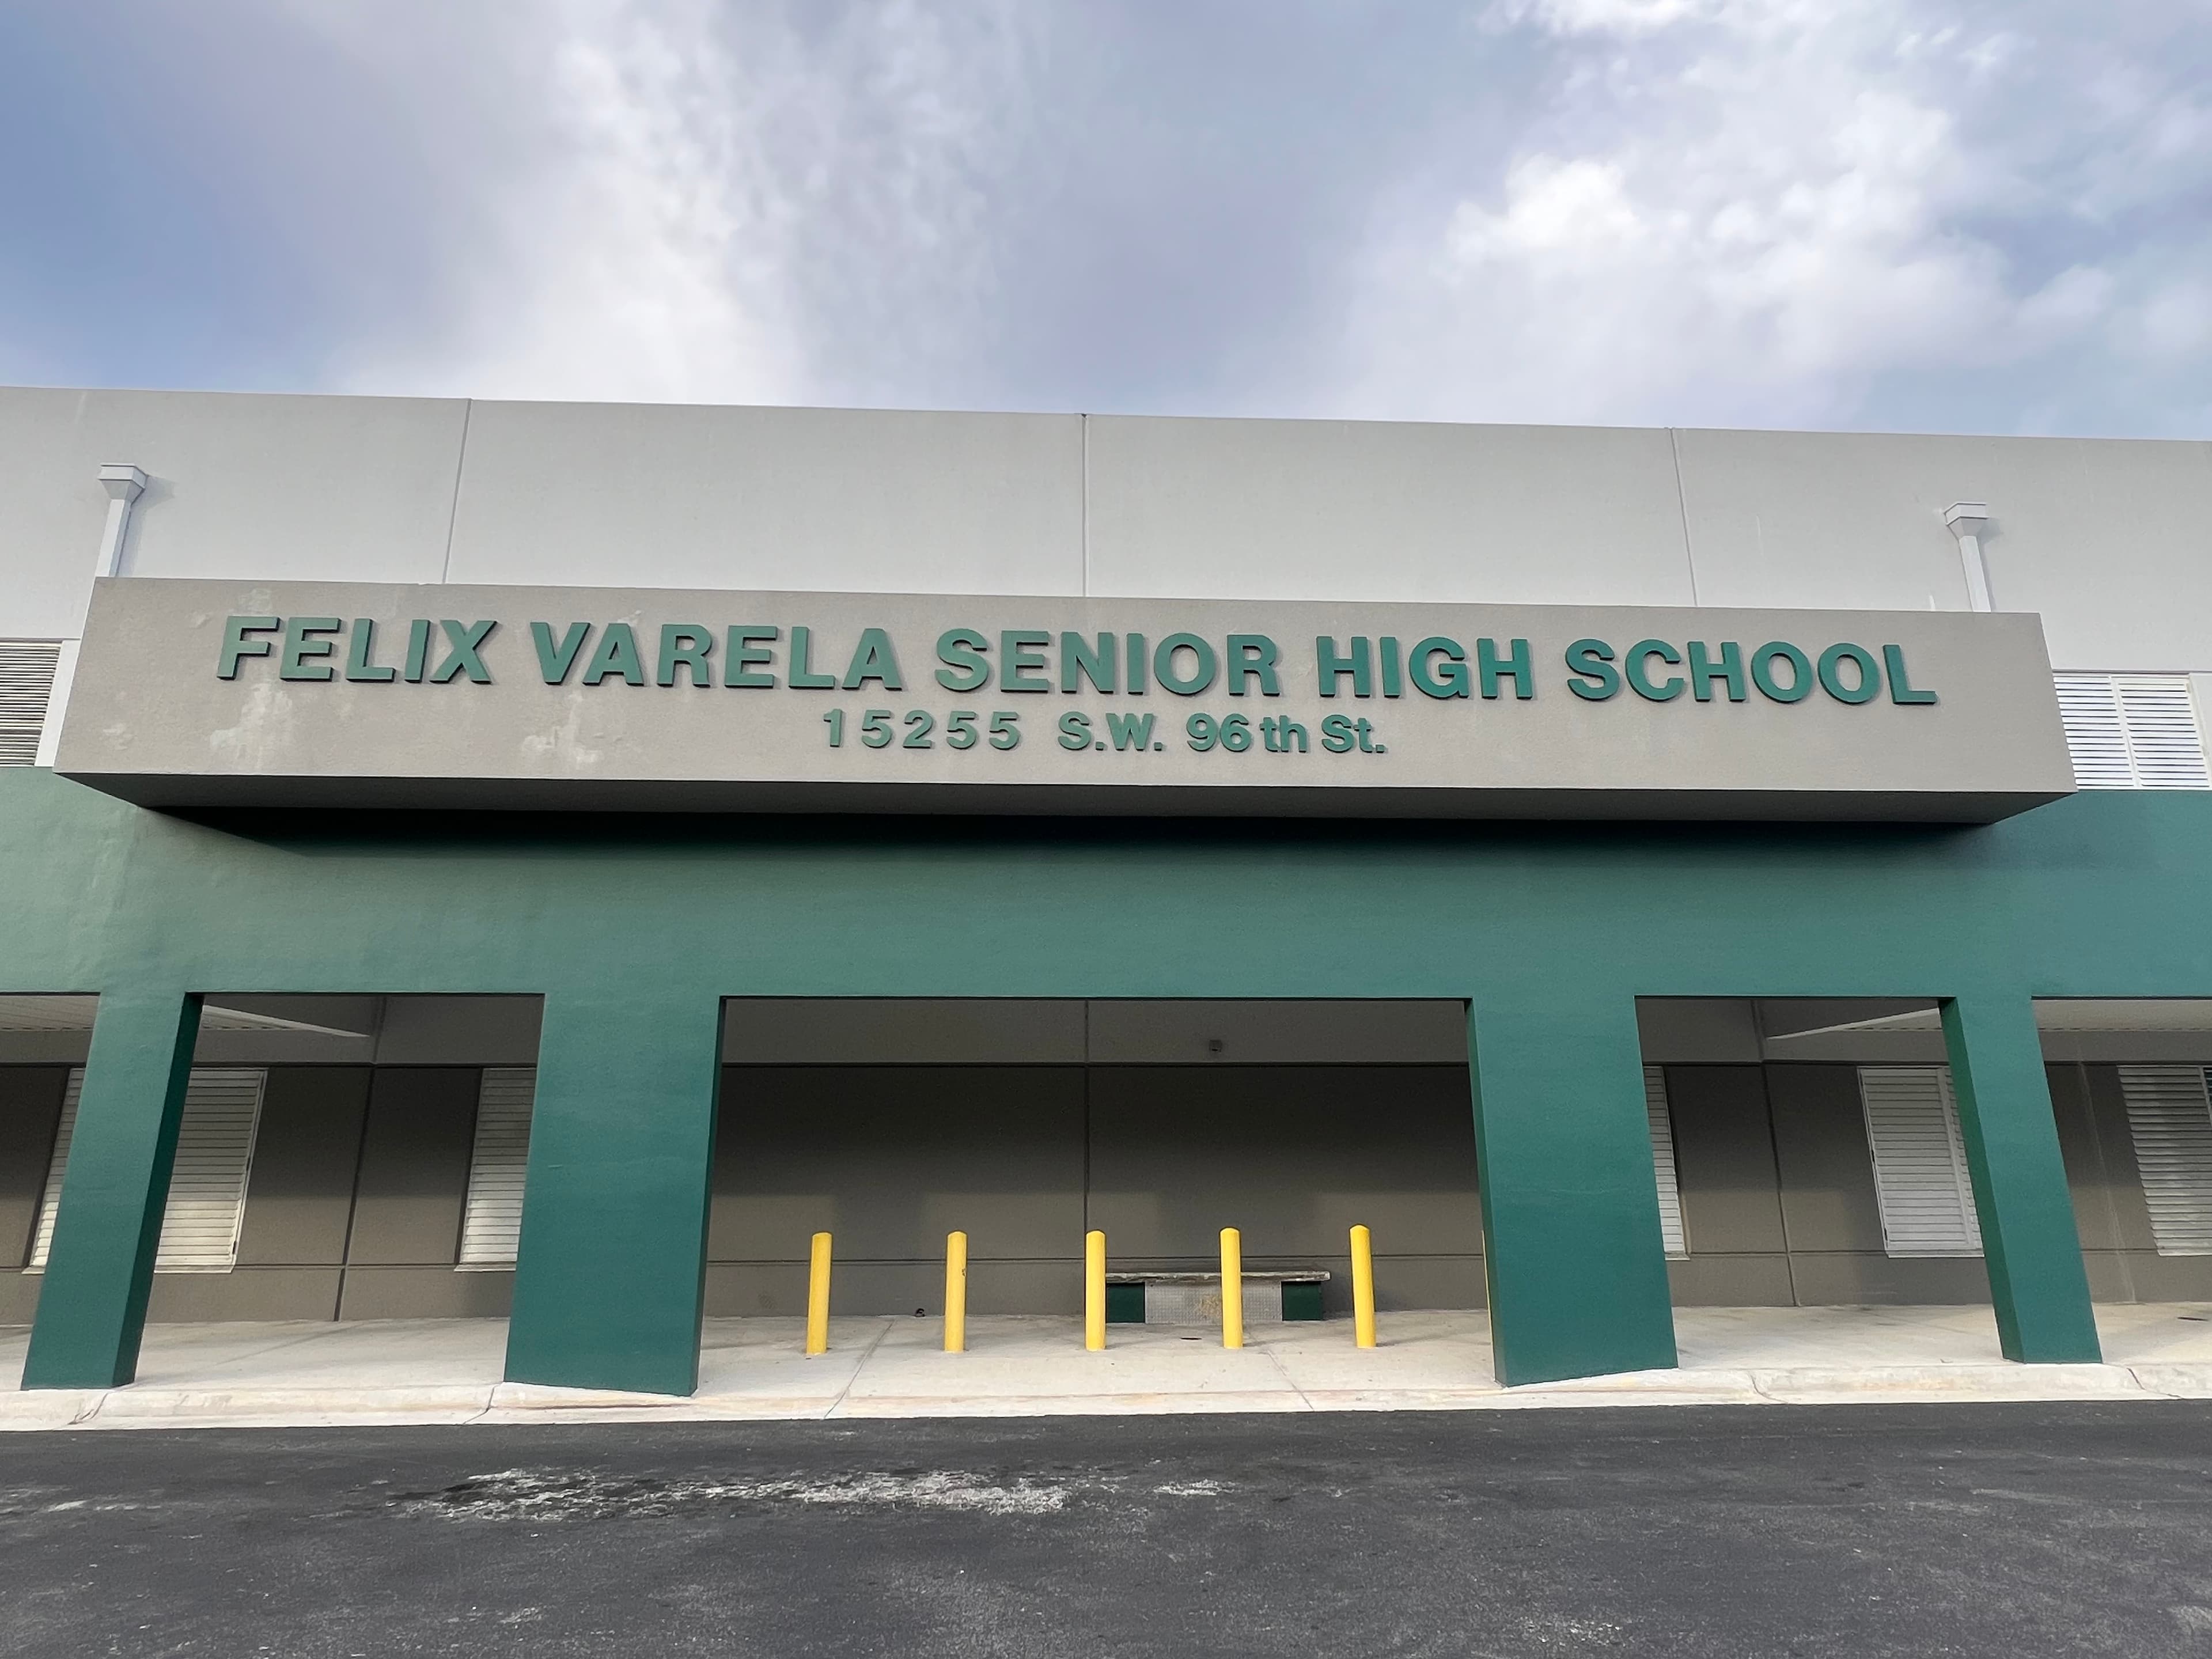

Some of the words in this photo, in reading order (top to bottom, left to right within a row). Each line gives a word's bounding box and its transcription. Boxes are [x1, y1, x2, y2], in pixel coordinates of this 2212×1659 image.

[217, 615, 496, 683] FELIX
[531, 622, 902, 690] VARELA
[935, 628, 1280, 695] SENIOR
[1316, 635, 1533, 699] HIGH
[1566, 639, 1937, 704] SCHOOL
[824, 709, 1019, 749] 15255
[1058, 711, 1162, 750] S.W.
[1187, 713, 1308, 752] 96th
[1321, 715, 1386, 753] St.
